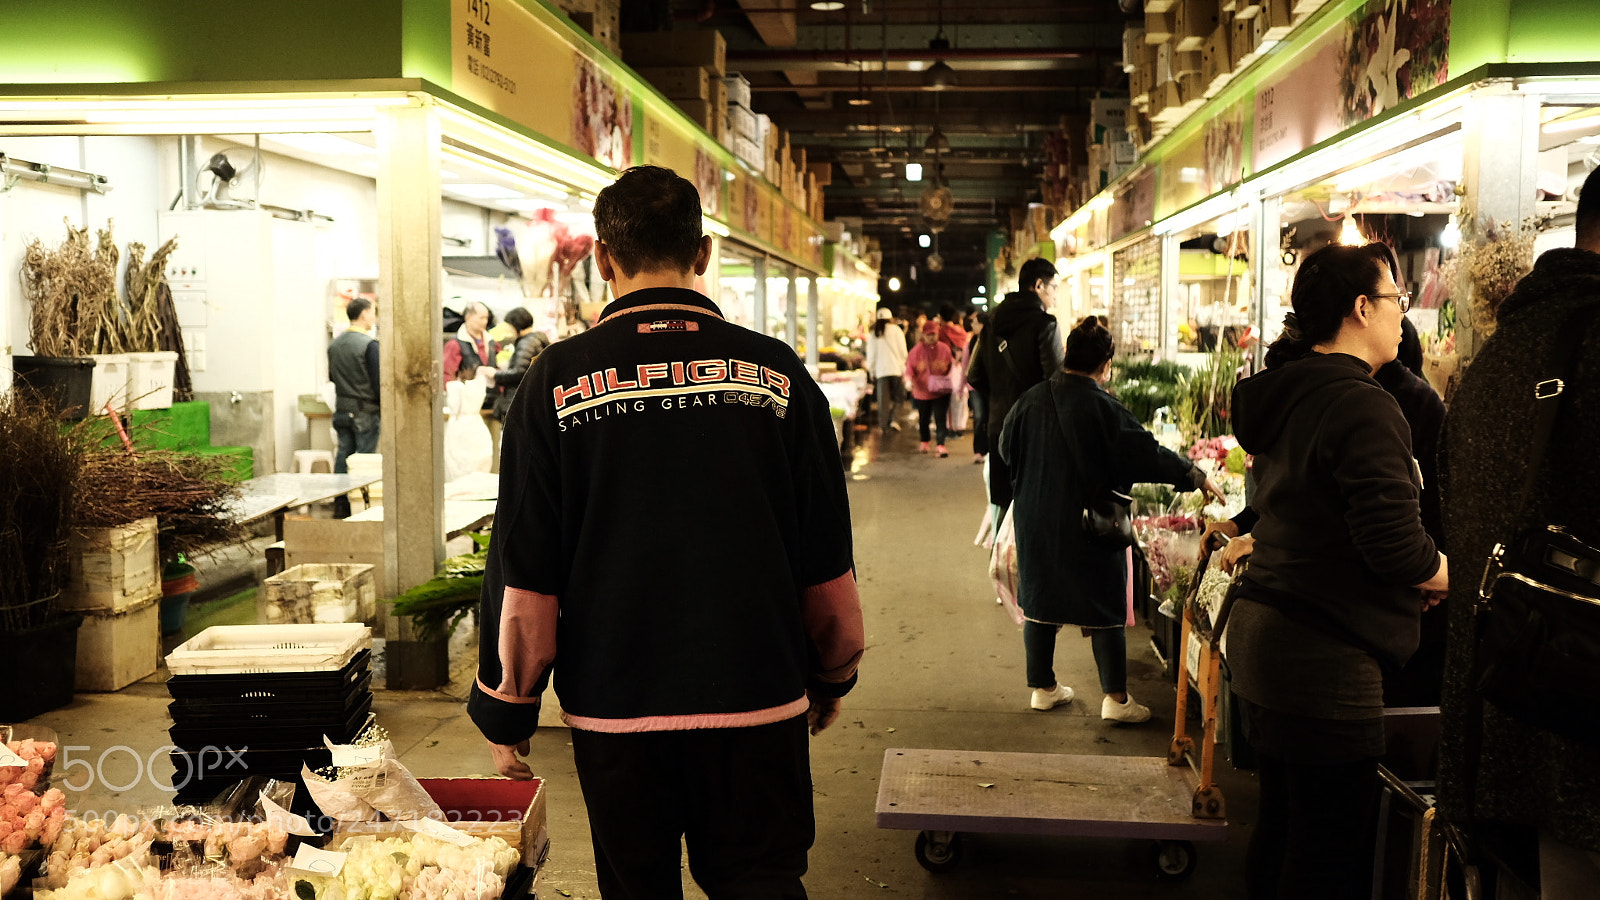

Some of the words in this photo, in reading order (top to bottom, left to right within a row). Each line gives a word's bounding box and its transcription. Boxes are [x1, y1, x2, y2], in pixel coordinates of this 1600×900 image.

[553, 358, 790, 410] HILFIGER
[558, 400, 646, 432] SAILING
[661, 394, 717, 410] GEAR
